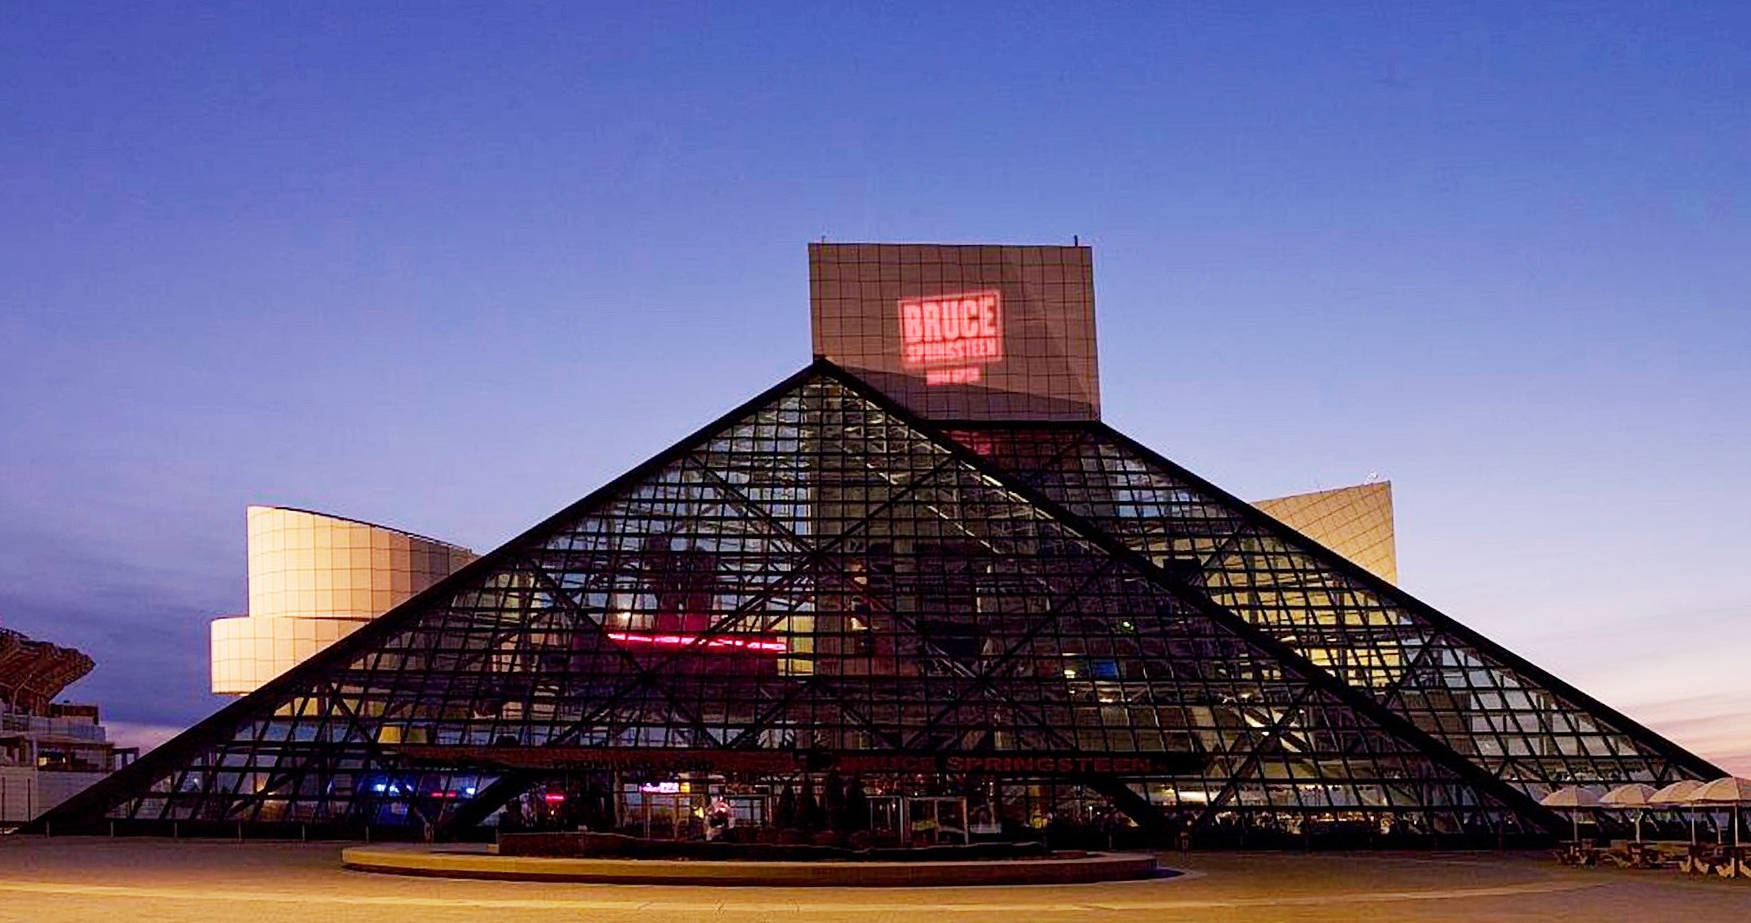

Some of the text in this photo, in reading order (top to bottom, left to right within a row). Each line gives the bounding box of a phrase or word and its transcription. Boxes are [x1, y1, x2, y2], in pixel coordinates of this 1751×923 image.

[903, 295, 996, 343] BRUCE
[841, 756, 1151, 773] UCE SPRINGSTEEN
